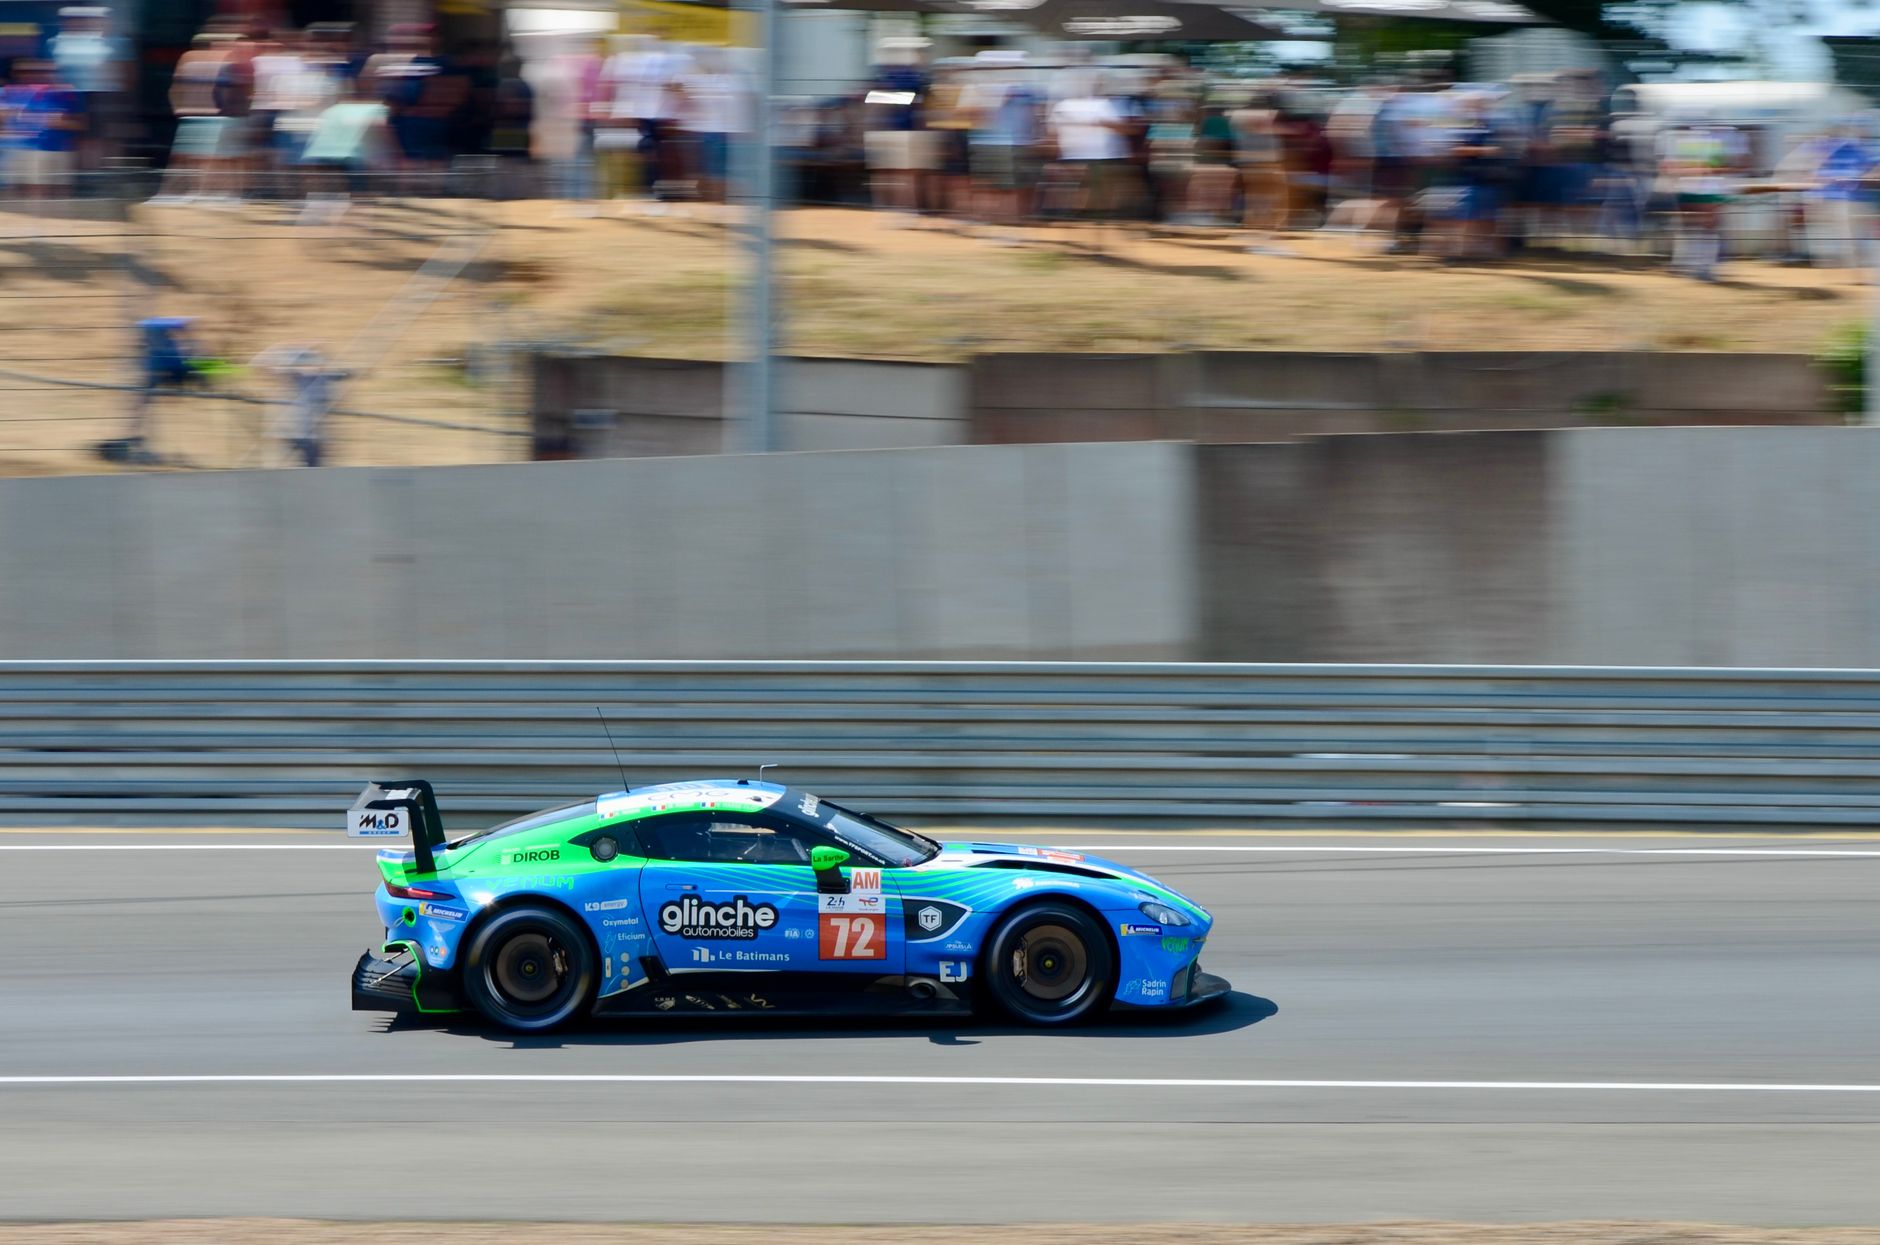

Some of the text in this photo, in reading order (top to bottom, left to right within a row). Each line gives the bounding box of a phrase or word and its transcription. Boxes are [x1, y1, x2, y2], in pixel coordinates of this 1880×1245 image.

[513, 849, 561, 863] DIROB
[852, 871, 880, 890] AM
[584, 902, 600, 912] K9
[662, 898, 775, 933] glinche
[922, 914, 938, 924] TF
[682, 926, 754, 937] automobiles
[830, 917, 875, 957] 72
[719, 950, 790, 962] Le Batimans
[939, 960, 968, 983] EJ
[1142, 979, 1167, 988] Sadrin
[1141, 987, 1164, 997] Rapin
